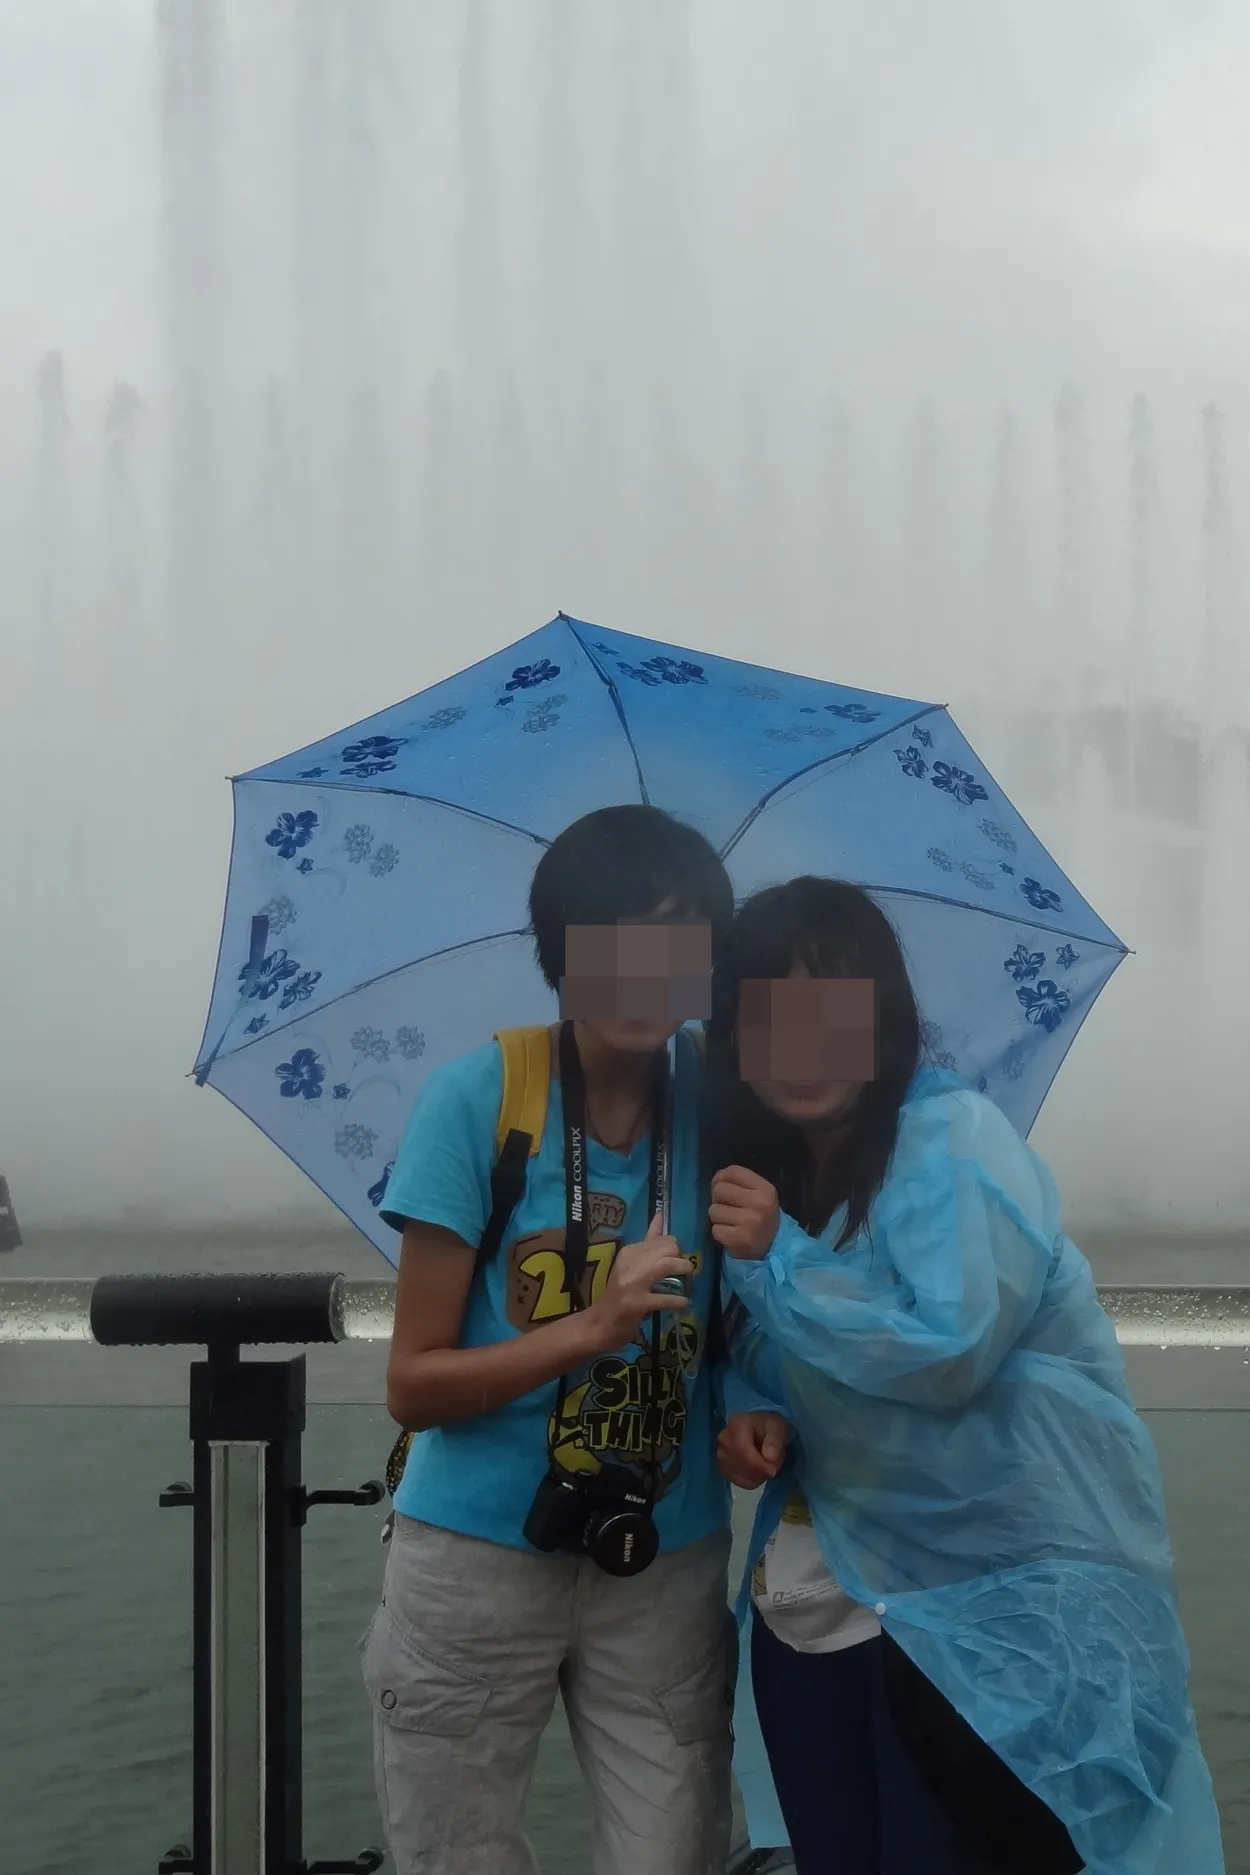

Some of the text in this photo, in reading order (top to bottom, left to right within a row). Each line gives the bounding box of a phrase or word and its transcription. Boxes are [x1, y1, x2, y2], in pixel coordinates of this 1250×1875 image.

[571, 1126, 582, 1222] Nikon COOLPIX
[590, 1357, 681, 1408] SILLY
[584, 1401, 686, 1451] THING
[624, 1493, 647, 1505] Nikon
[623, 1533, 634, 1563] Nikon
